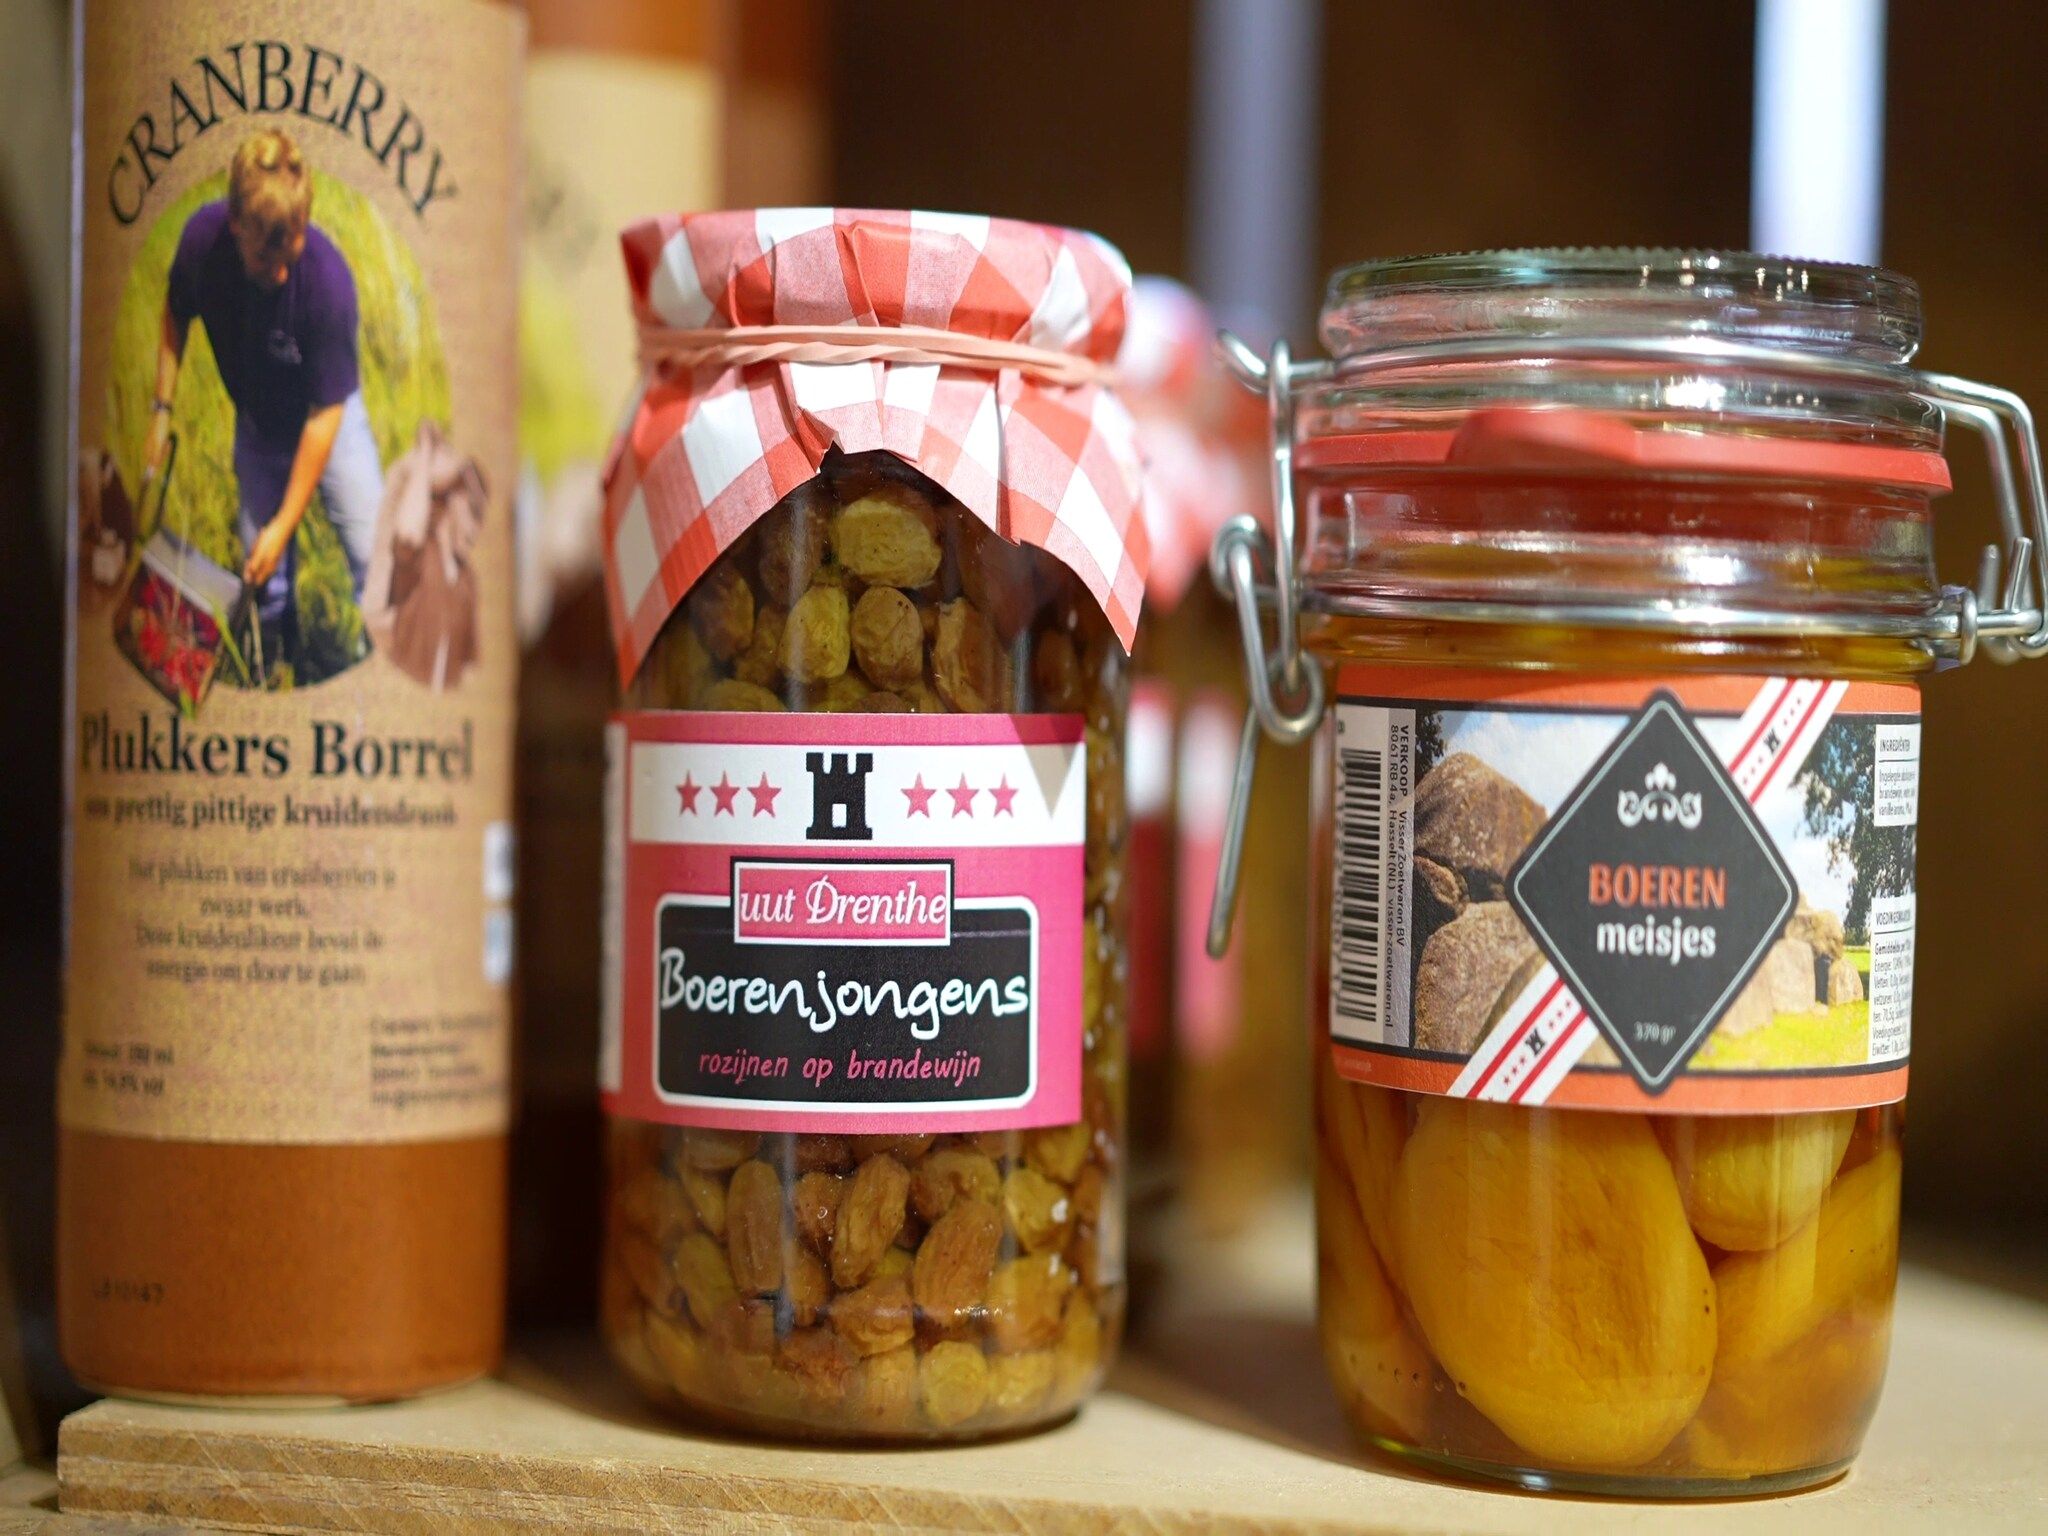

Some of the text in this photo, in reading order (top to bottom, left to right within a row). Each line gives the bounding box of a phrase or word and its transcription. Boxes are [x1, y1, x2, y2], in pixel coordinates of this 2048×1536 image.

[107, 40, 456, 226] CRANBERRY
[82, 711, 475, 782] Plukkers Borrel
[192, 794, 277, 832] pittige
[1388, 810, 1397, 860] Hasselt
[1396, 725, 1409, 947] VERKOOP Visser Zoetwaren BV
[740, 874, 947, 925] uut Drenthe
[1387, 861, 1396, 890] (NL)
[1588, 861, 1728, 909] BOEREN
[1597, 914, 1717, 966] meisjes
[660, 947, 1030, 1040] Boerenjongens
[700, 1048, 981, 1087] rozijnen op brandewijn
